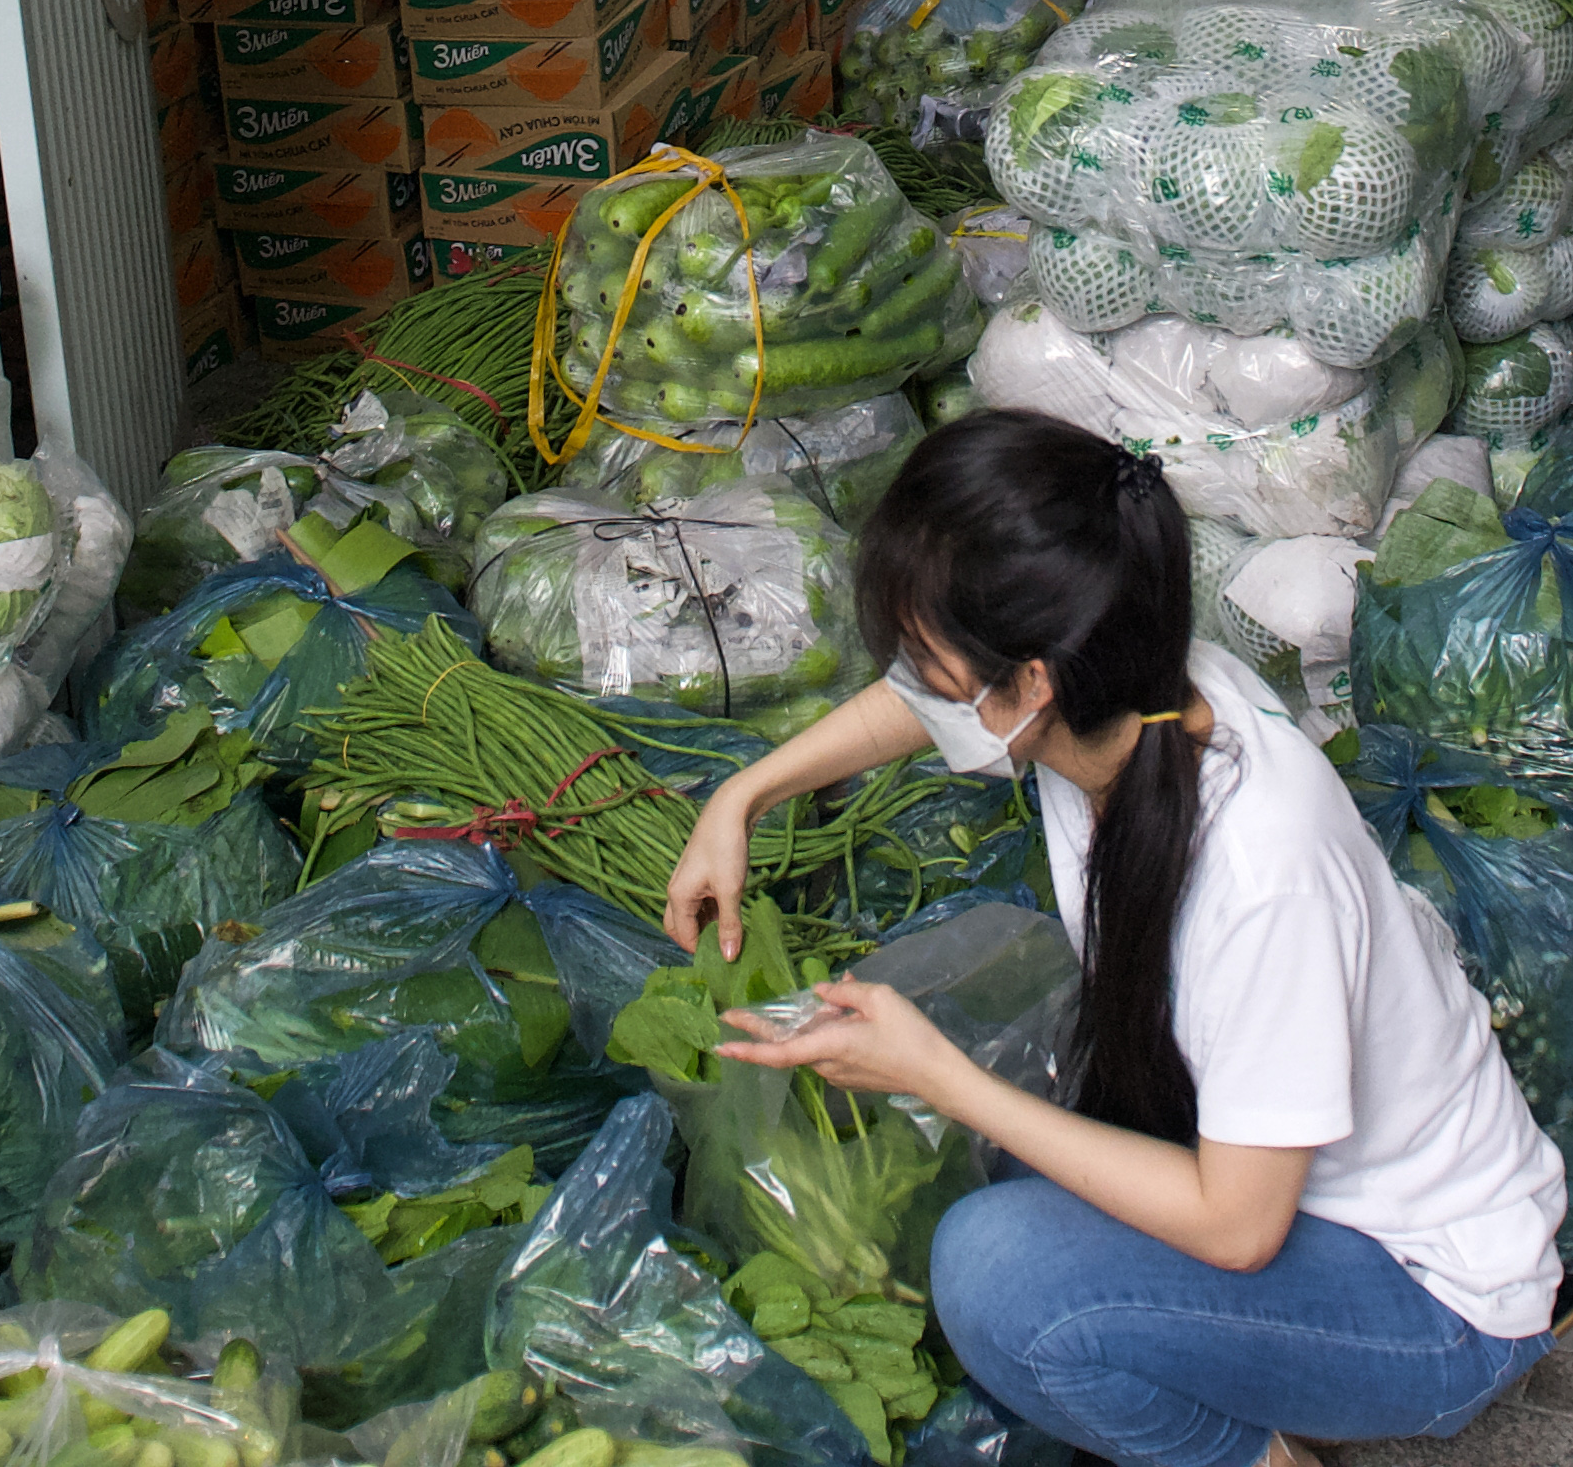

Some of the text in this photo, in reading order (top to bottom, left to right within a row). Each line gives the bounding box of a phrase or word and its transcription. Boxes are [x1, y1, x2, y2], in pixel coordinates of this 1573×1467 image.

[499, 117, 560, 139] CHUA CAY
[275, 144, 306, 159] CHUA
[308, 135, 331, 153] CAY
